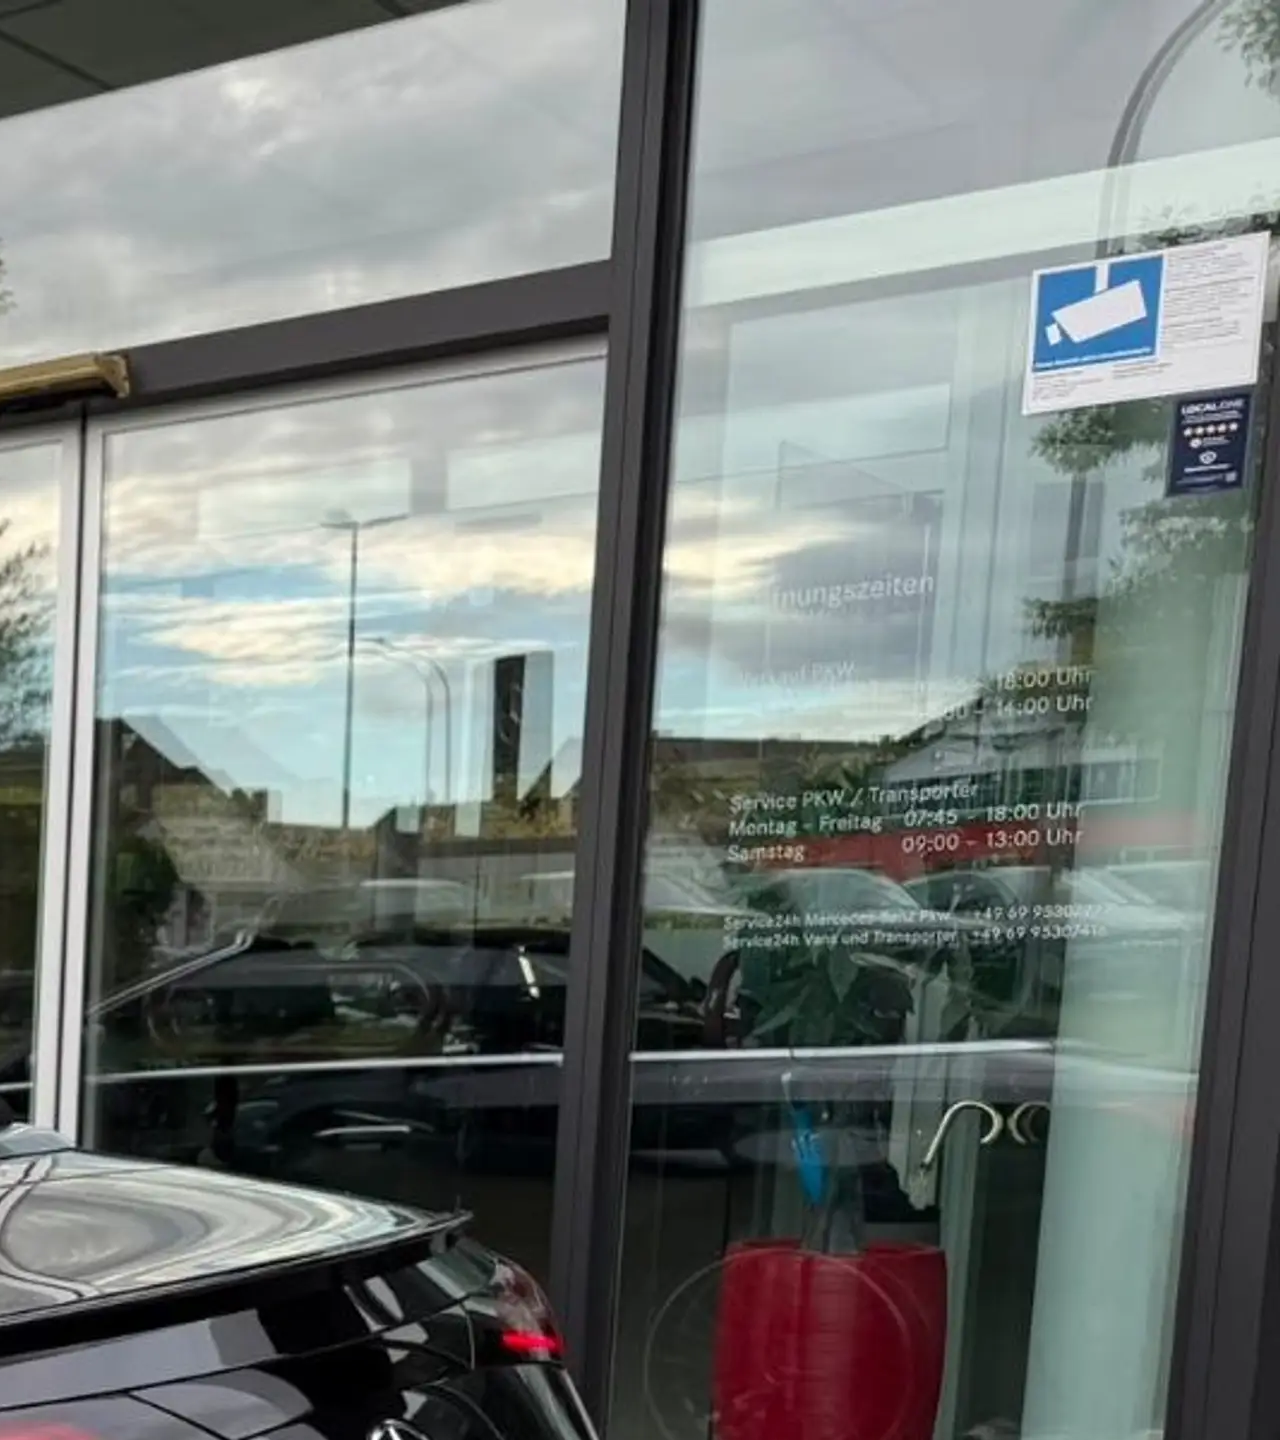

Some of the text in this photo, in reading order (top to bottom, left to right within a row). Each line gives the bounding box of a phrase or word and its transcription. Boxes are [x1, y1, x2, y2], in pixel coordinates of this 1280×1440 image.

[1056, 665, 1093, 686] Uhr
[996, 696, 1049, 717] 14:00
[1056, 695, 1093, 713] Uhr
[729, 793, 797, 812] Service
[802, 789, 845, 808] PKW
[868, 782, 980, 804] Transporter
[729, 819, 798, 838] Montag
[819, 814, 883, 834] Freitag
[903, 809, 958, 828] 07:45
[986, 803, 1040, 822] 18:00
[1046, 801, 1085, 820] Uhr
[728, 844, 805, 862] Samstag
[901, 833, 960, 853] 09:00
[986, 829, 1040, 849] 13:00
[1046, 828, 1085, 846] Uhr
[1006, 905, 1029, 920] 69
[1006, 925, 1027, 940] 69
